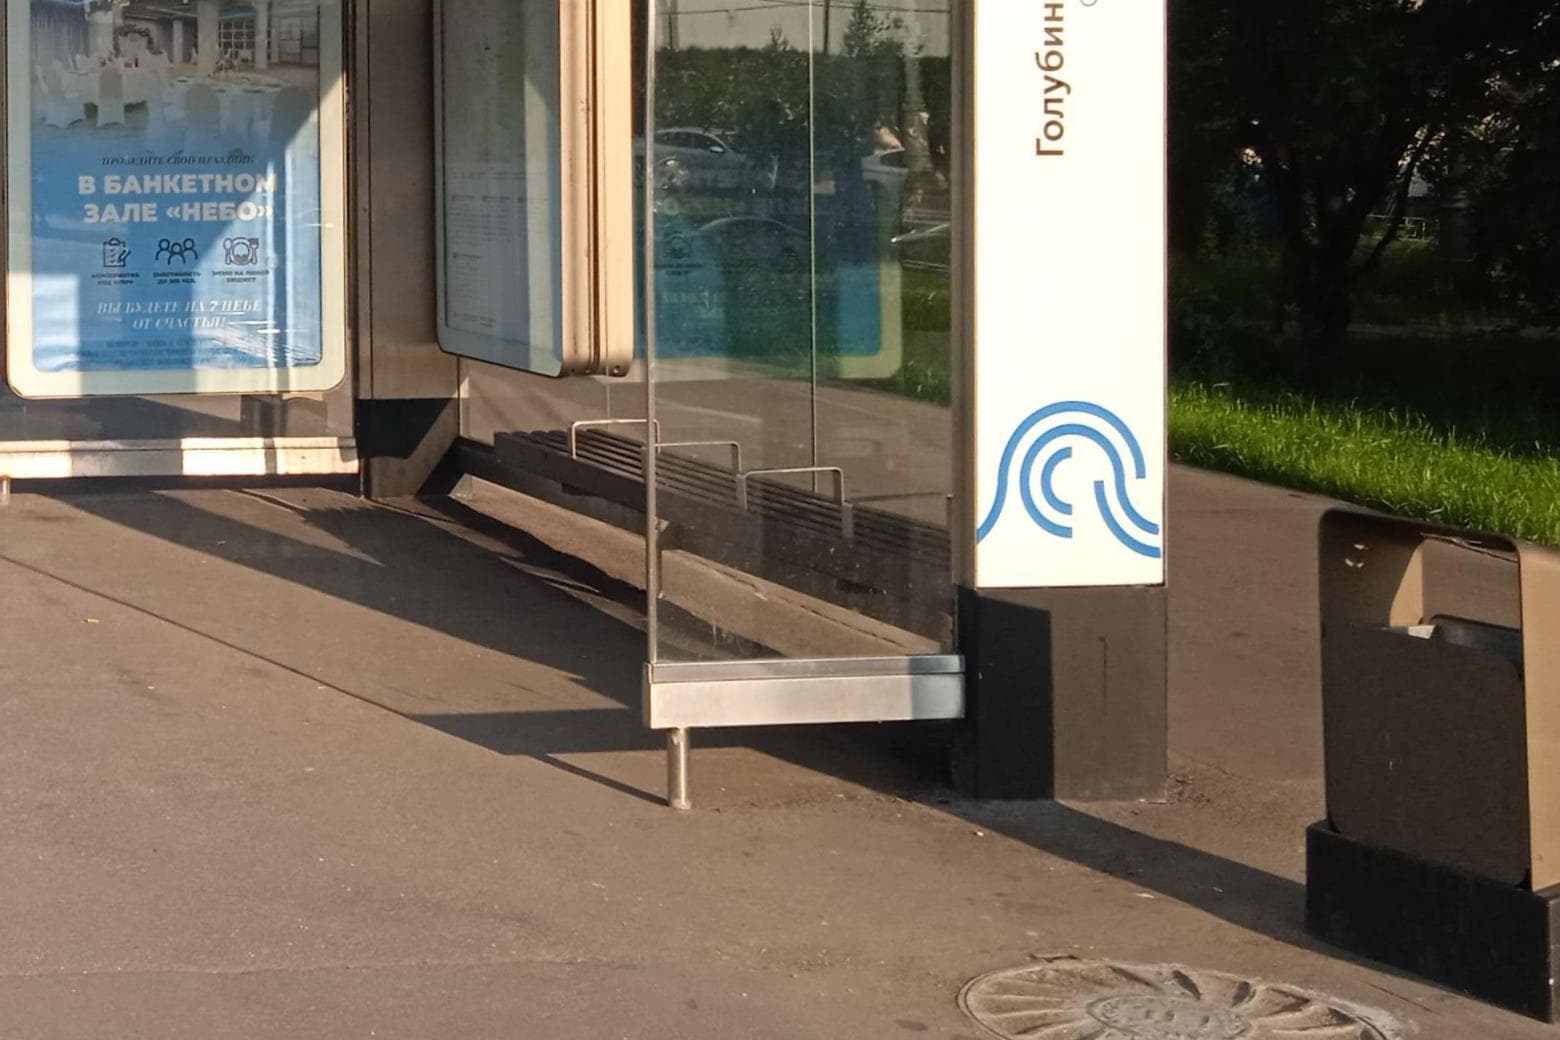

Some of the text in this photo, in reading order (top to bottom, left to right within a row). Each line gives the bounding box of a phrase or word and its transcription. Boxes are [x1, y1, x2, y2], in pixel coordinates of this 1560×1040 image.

[78, 173, 277, 195] В БАНКЕТНОМ
[83, 201, 273, 224] ЗАЛЕ «НЕБО»
[209, 300, 218, 312] 7
